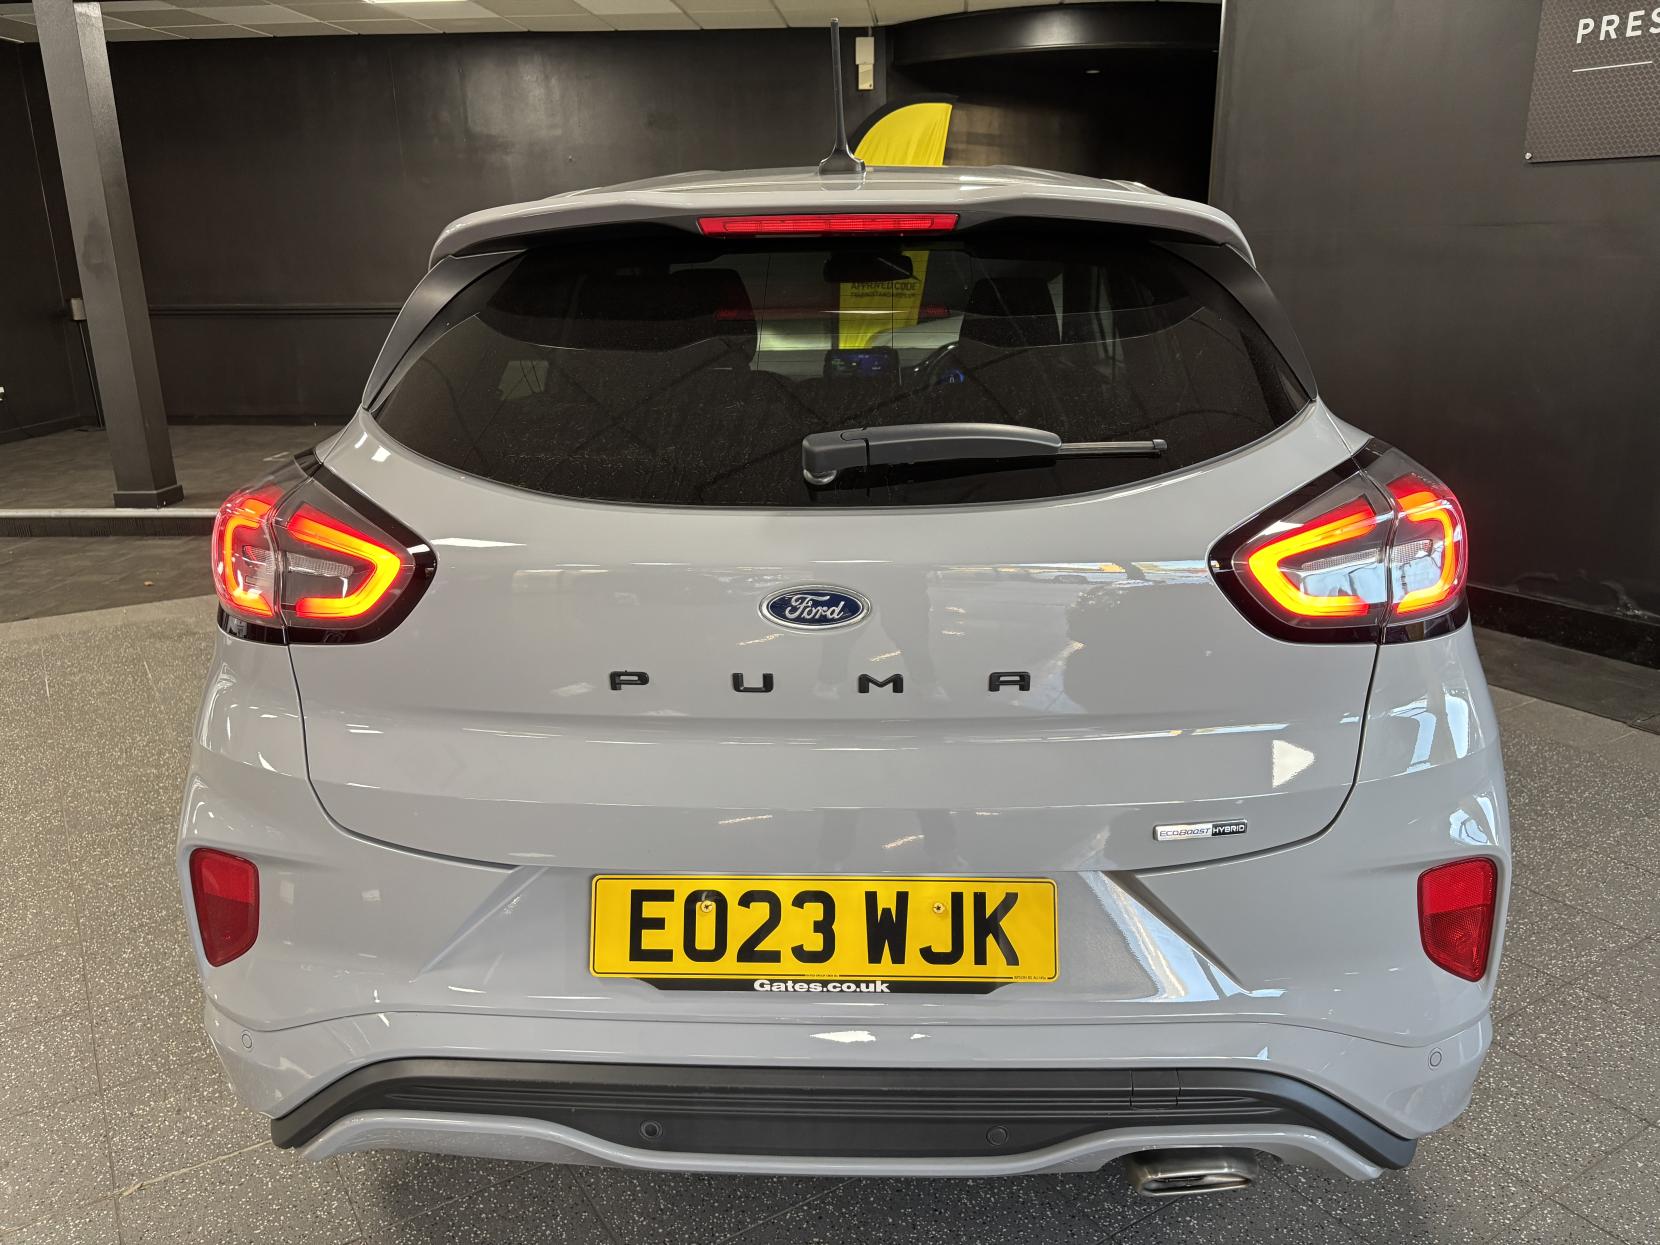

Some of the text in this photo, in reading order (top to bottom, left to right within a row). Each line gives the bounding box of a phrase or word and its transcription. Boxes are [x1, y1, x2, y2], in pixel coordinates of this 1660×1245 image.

[894, 281, 917, 290] CODE
[785, 594, 845, 619] Ford
[609, 670, 1031, 694] PUMA
[1212, 824, 1245, 834] HYBRID
[628, 888, 1019, 966] EO23 WJK
[753, 979, 891, 993] Gates.co.uk
